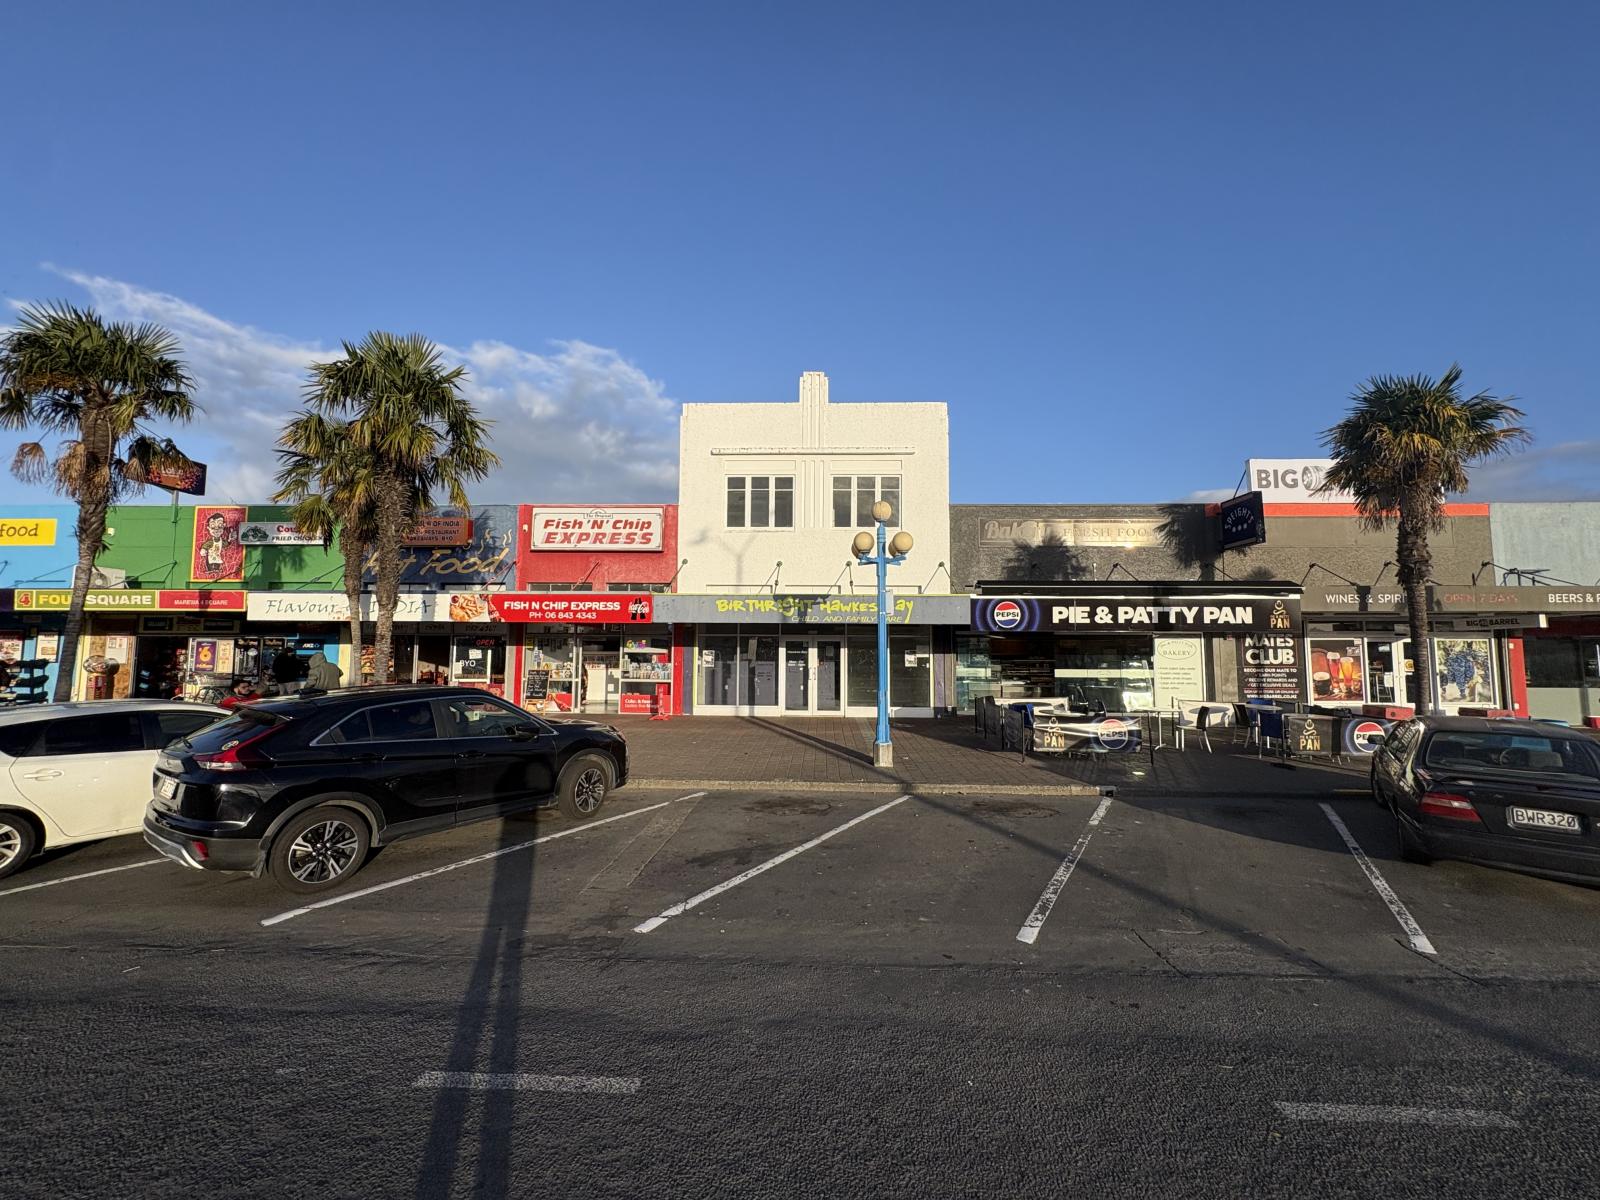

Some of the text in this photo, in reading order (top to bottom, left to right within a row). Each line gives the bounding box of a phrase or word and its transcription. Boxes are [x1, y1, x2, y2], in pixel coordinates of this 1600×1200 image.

[1256, 469, 1299, 489] BIG
[0, 523, 39, 537] food
[543, 519, 583, 529] Fish
[611, 519, 652, 531] Chip
[543, 532, 653, 544] EXPRESS
[419, 547, 510, 576] Food
[39, 595, 71, 605] FOU
[85, 595, 152, 605] SQUARE
[1325, 594, 1360, 603] WINES
[1366, 595, 1374, 603] &
[1443, 594, 1474, 603] OPEN
[1548, 593, 1584, 603] BEERS
[1585, 593, 1594, 603] &
[503, 602, 621, 610] FISH N CHIP EXPRESS
[1052, 606, 1253, 624] PIE & PATTY PAN
[1270, 618, 1290, 628] PAN
[1244, 633, 1294, 647] MATES
[1245, 648, 1295, 665] CLUB
[1044, 736, 1064, 747] PAN
[1299, 739, 1320, 750] PAN
[1514, 810, 1577, 828] BWR320
